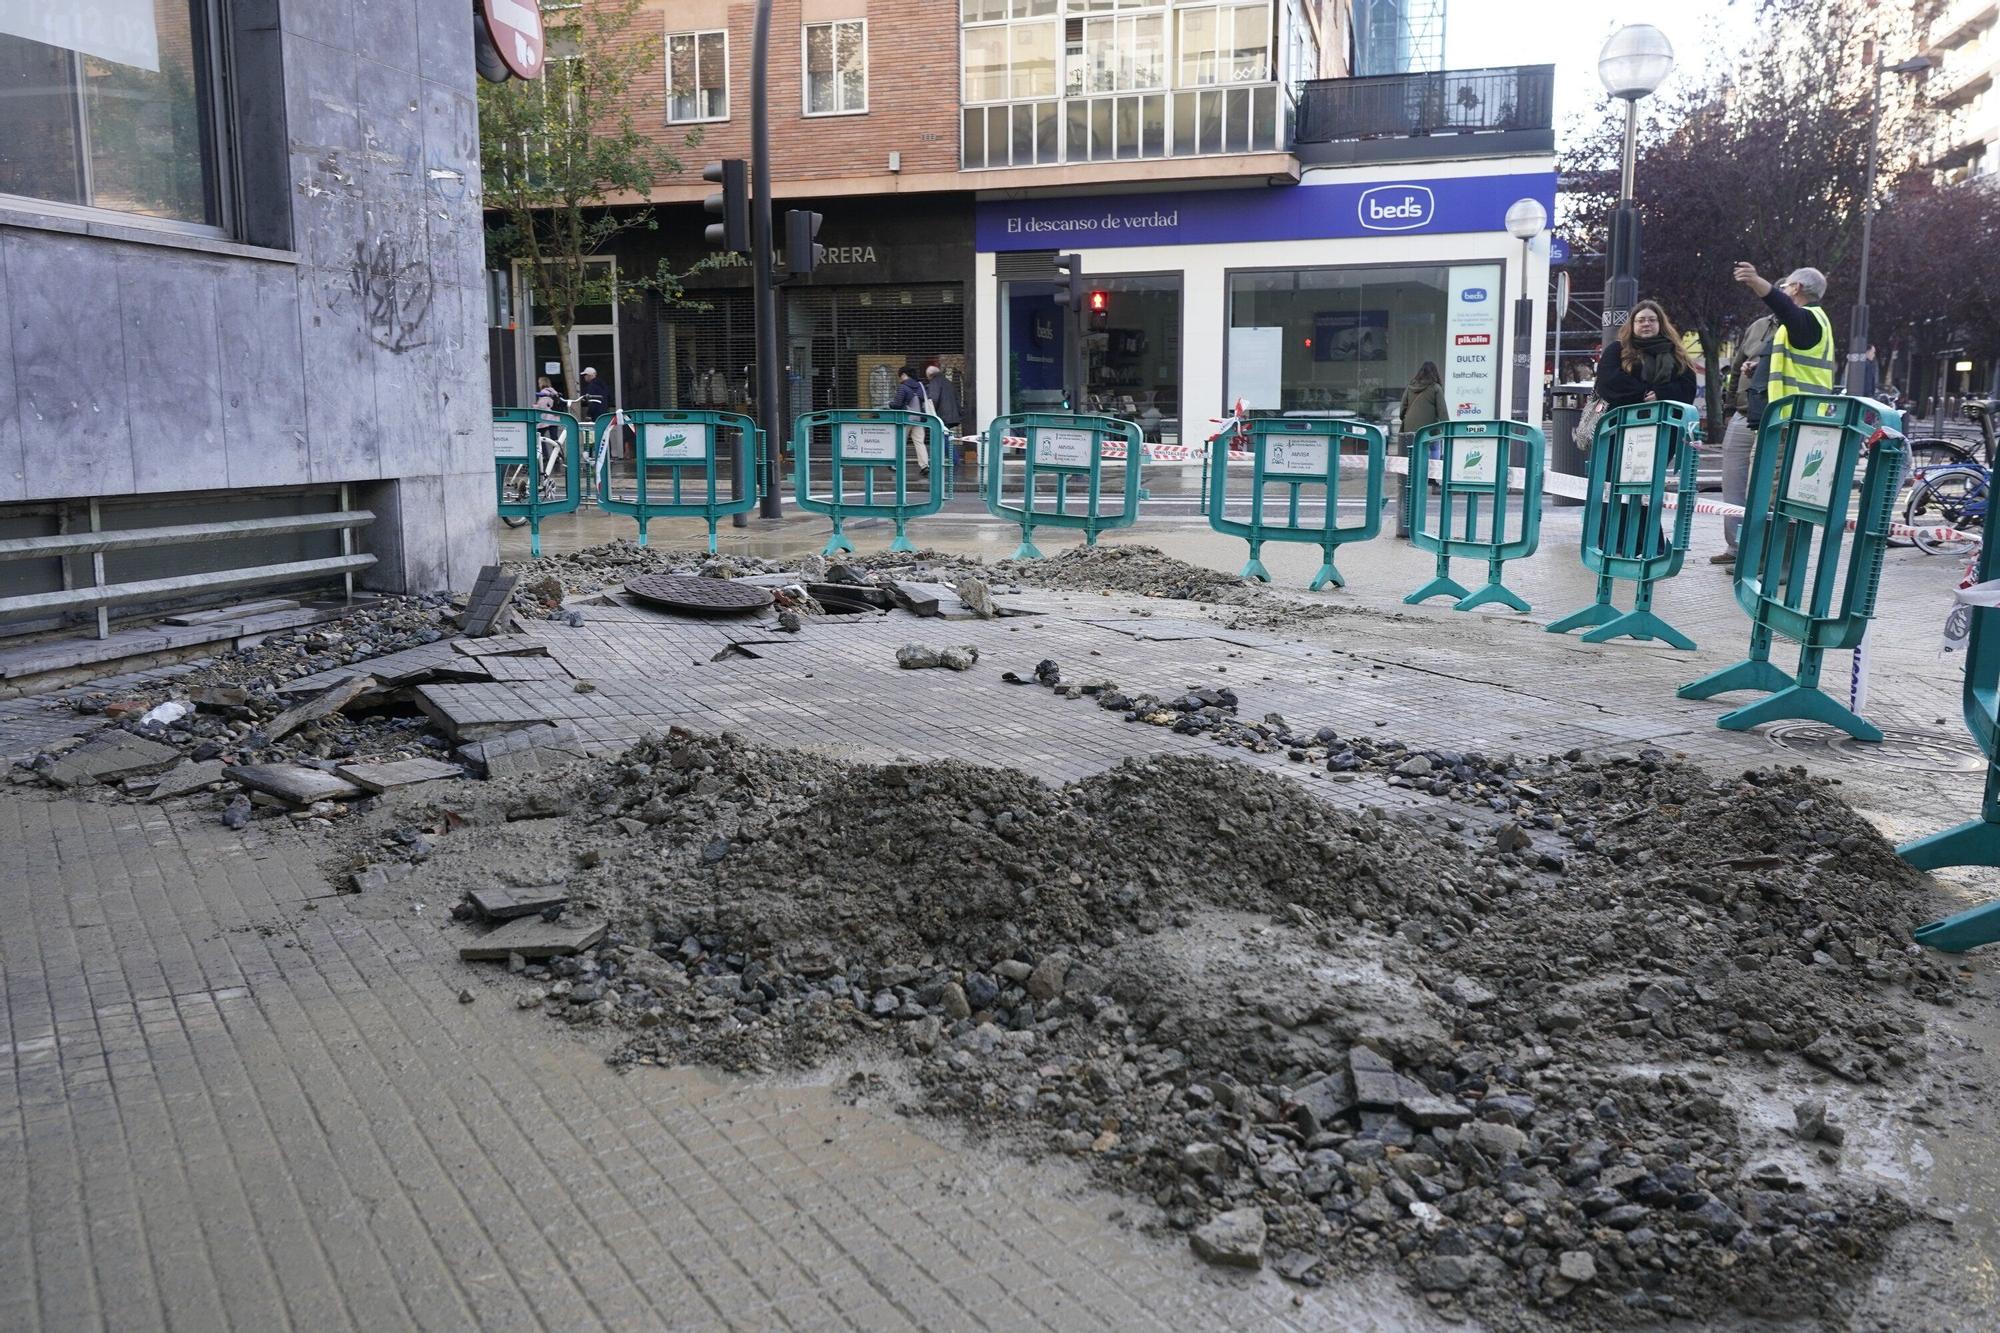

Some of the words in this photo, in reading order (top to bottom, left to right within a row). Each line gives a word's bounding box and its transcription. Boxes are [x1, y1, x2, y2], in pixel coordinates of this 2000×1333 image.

[1007, 218, 1022, 233] El
[1025, 217, 1098, 232] descanso
[1101, 214, 1121, 229] de
[1124, 210, 1178, 228] verdad
[1457, 335, 1488, 345] pikolin
[1456, 355, 1487, 363] BULTEX
